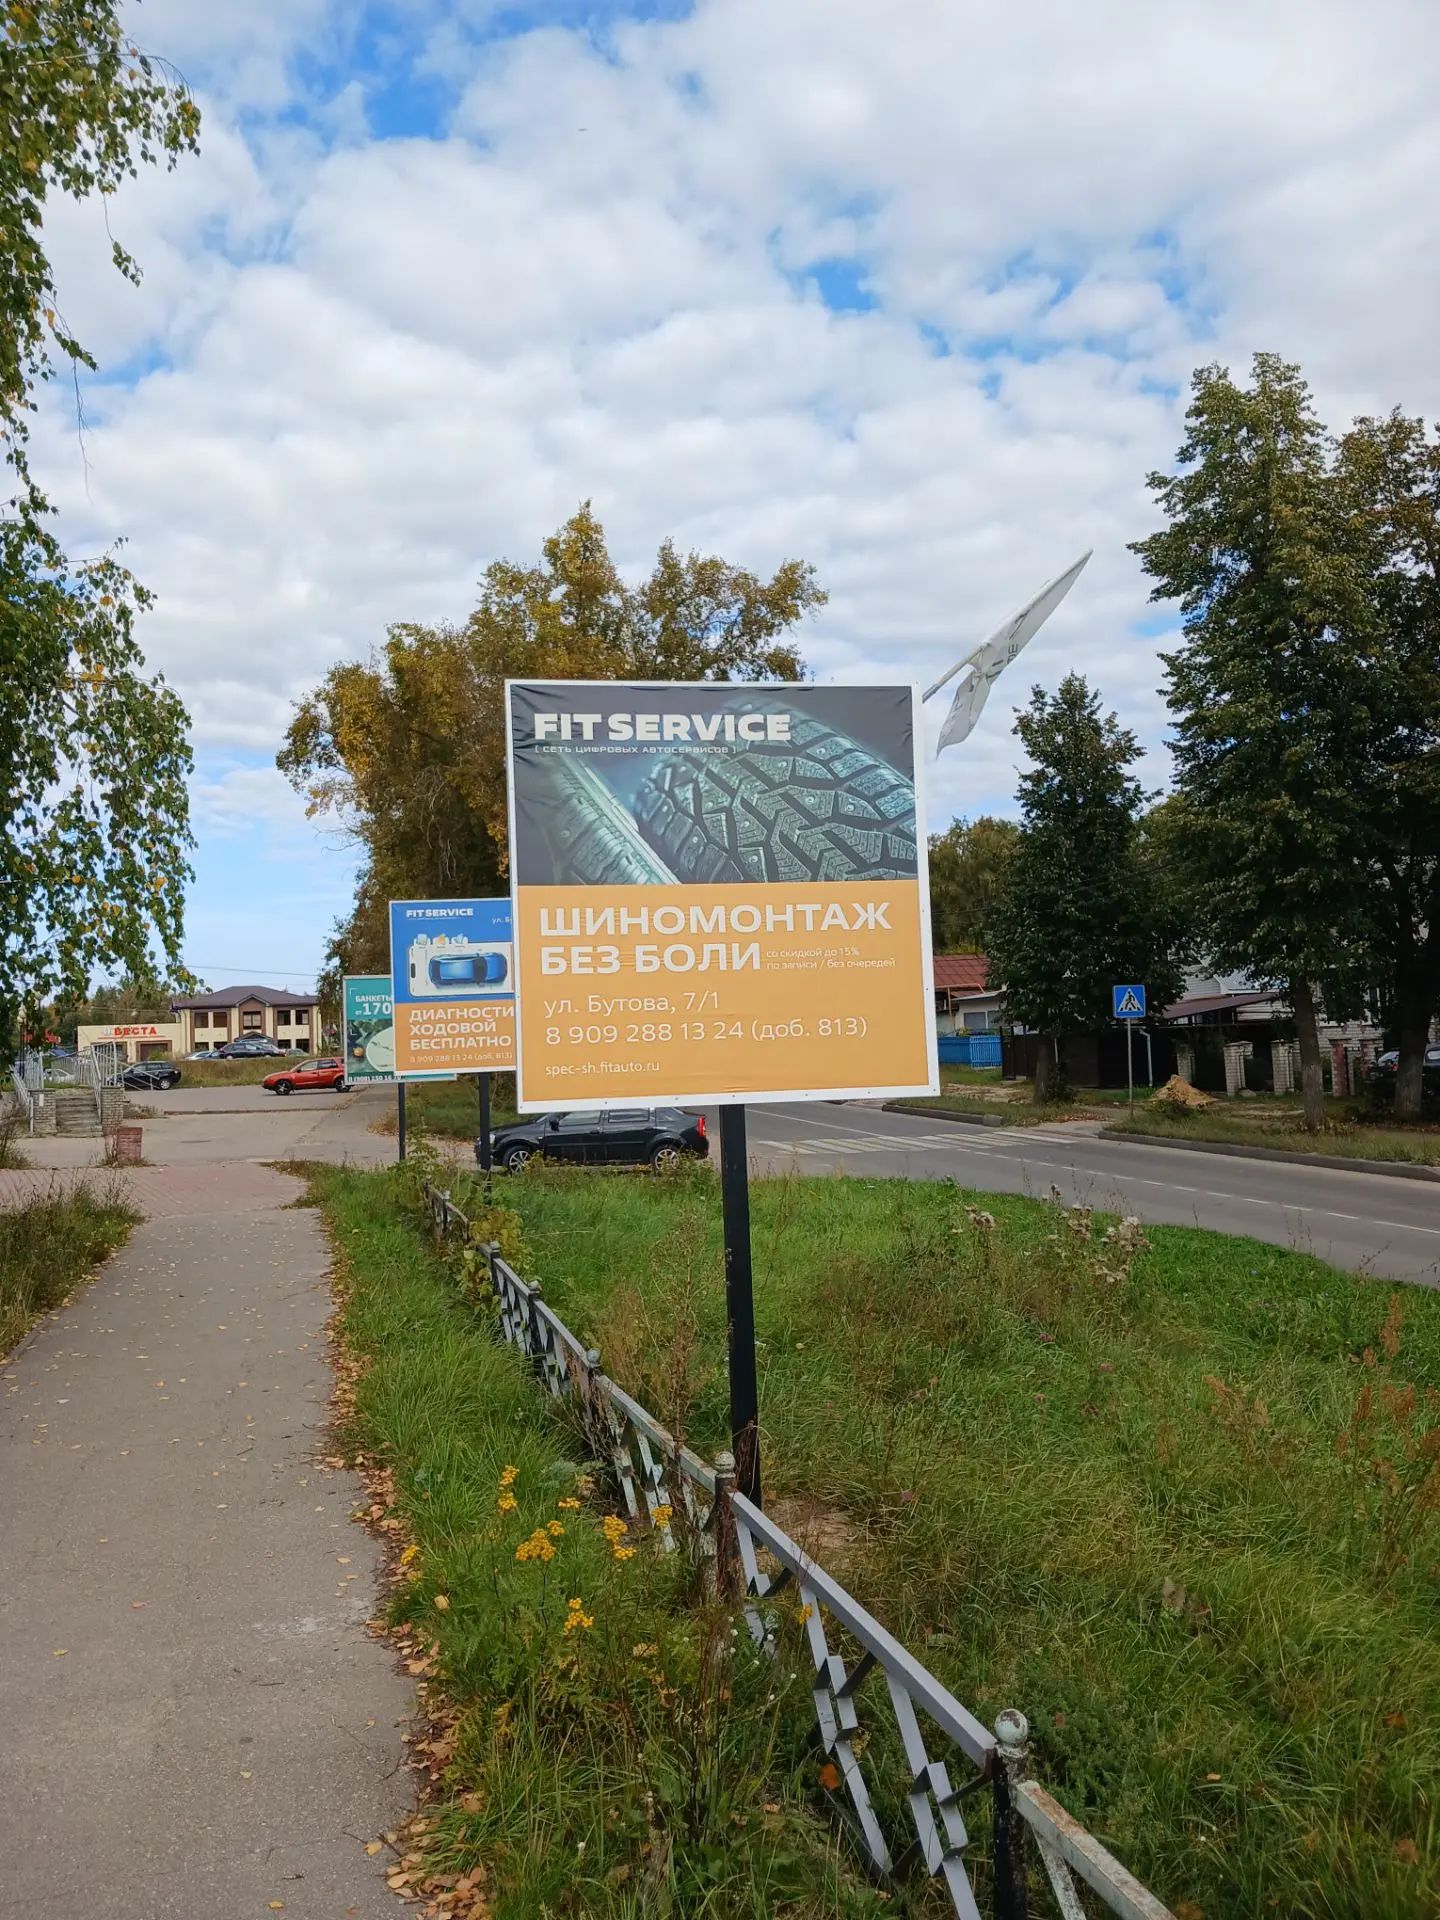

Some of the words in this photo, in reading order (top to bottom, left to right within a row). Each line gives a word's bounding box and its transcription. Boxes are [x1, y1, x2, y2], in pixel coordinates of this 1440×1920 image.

[534, 713, 602, 741] FIT
[608, 713, 791, 741] SERVICE
[575, 746, 638, 754] ЦИФРОВЫХ
[642, 746, 729, 754] АВТОСЕРВИСОВ
[406, 909, 424, 918] FIT
[425, 908, 473, 917] SERVICE
[540, 902, 892, 936] ШИНОМОНТАЖ
[541, 945, 621, 975] БЕЗ
[635, 943, 760, 973] БОЛИ
[780, 948, 822, 959] скидкой
[824, 949, 837, 959] до
[839, 947, 860, 957] 15%
[782, 961, 817, 969] записи
[827, 958, 845, 968] без
[846, 957, 896, 969] очередей
[544, 1000, 579, 1019] ул.
[588, 995, 676, 1016] Бутова,
[683, 990, 719, 1013] 7/1
[114, 1026, 157, 1036] ВЕСТА
[409, 1018, 496, 1037] ХОДОВОЙ
[546, 1027, 561, 1045] 8
[568, 1025, 617, 1044] 909
[626, 1023, 672, 1042] 288
[680, 1022, 705, 1040] 13
[713, 1021, 744, 1040] 24
[751, 1018, 811, 1041] (доб.
[818, 1016, 868, 1038] 813)
[410, 1035, 512, 1051] БЕСПЛАТНО
[545, 1061, 660, 1077] spec-sh.fitauto.ru
